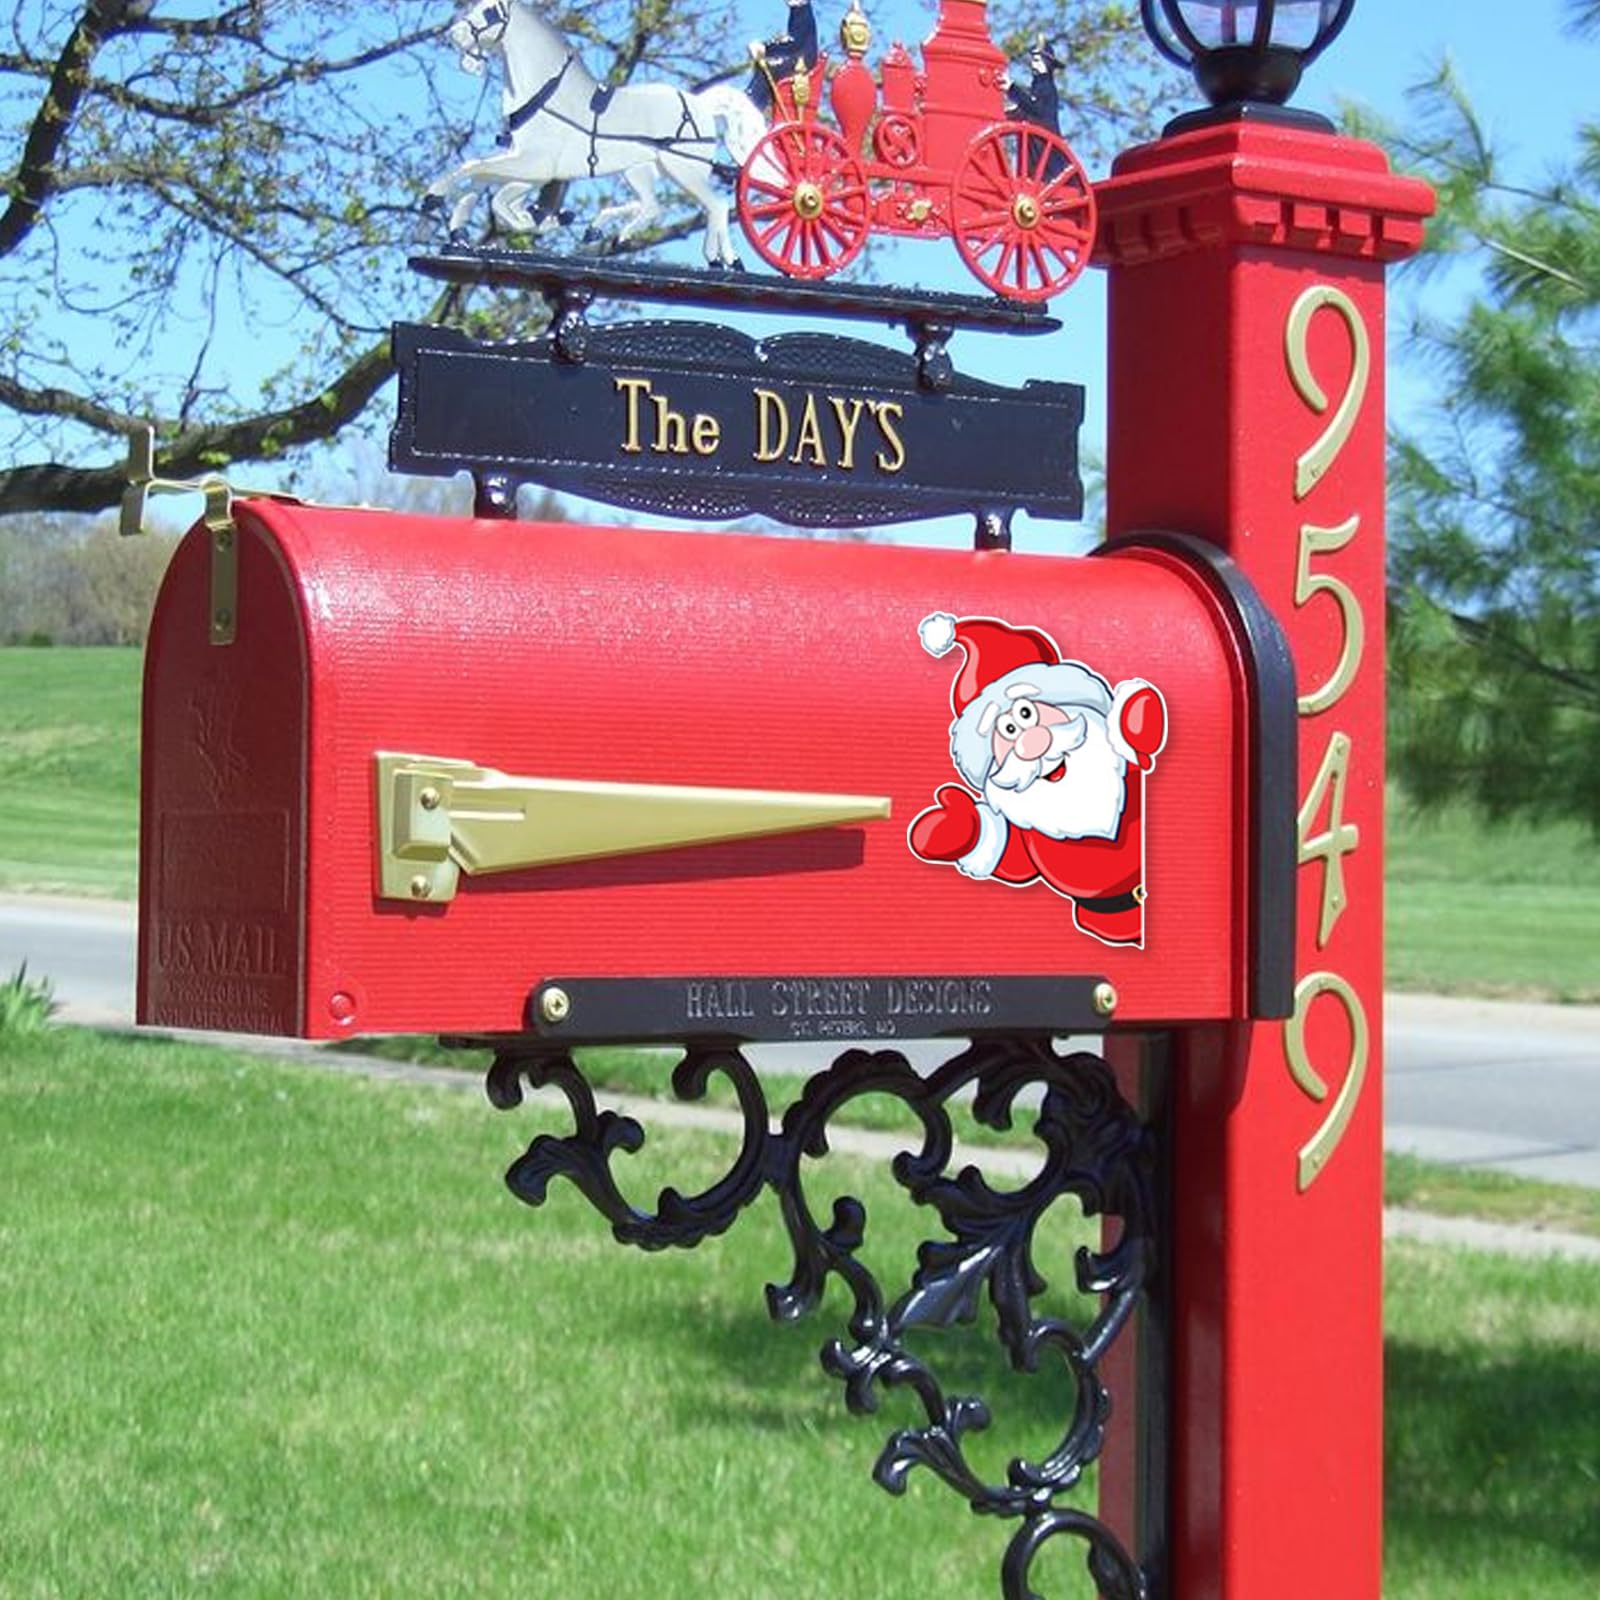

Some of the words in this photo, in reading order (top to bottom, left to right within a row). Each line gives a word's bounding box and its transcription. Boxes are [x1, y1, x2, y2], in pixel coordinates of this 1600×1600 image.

[614, 377, 721, 455] The
[752, 387, 906, 472] DAY'S
[1284, 285, 1370, 1192] 9549
[201, 918, 285, 975] MAIL
[686, 981, 755, 1019] HALL
[771, 979, 871, 1016] STREET
[886, 979, 992, 1015] DESIGNS
